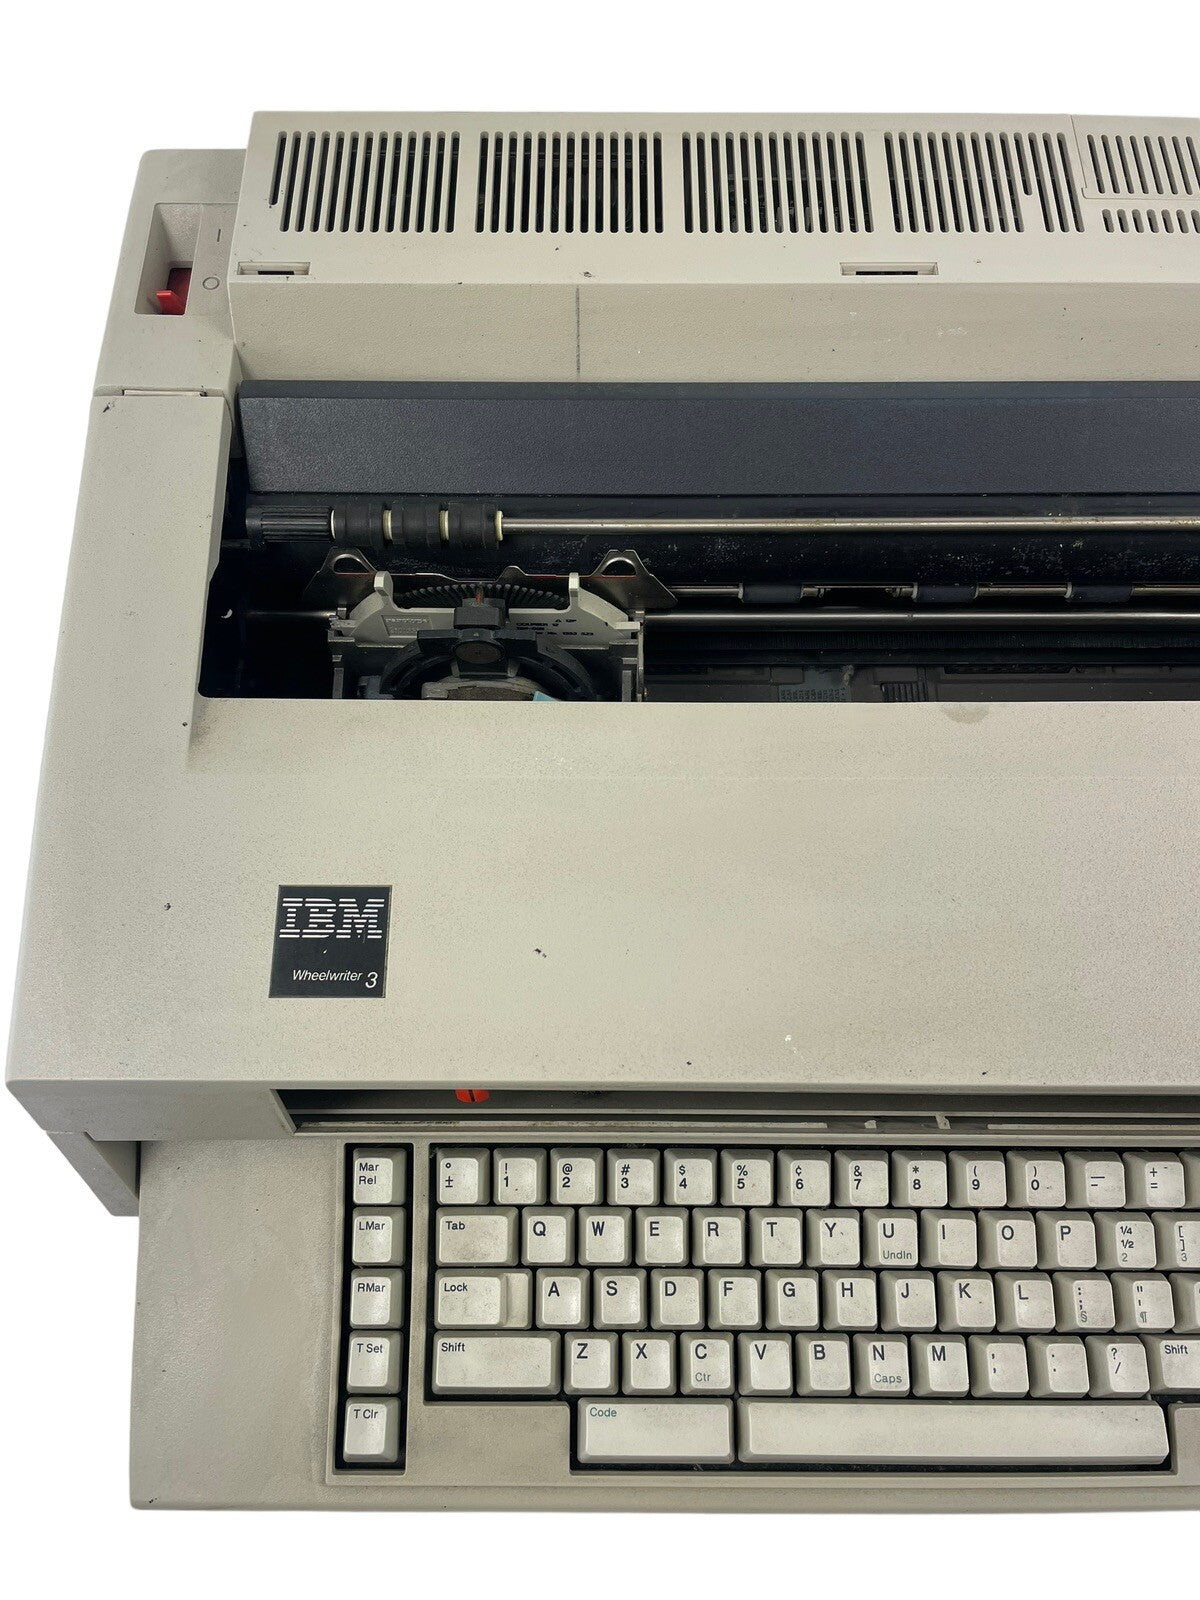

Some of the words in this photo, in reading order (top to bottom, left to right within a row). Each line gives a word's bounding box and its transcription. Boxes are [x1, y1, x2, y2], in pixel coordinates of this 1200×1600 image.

[279, 898, 385, 938] IBM
[292, 969, 363, 981] Wheelwriter
[365, 971, 378, 989] 3
[358, 1162, 380, 1172] Mar
[561, 1162, 573, 1176] @
[620, 1163, 631, 1176] #
[678, 1164, 686, 1177] $
[736, 1164, 749, 1177] %
[853, 1164, 863, 1177] &
[1149, 1167, 1158, 1178] +
[358, 1175, 377, 1185] Rel
[503, 1175, 509, 1188] 1
[561, 1176, 571, 1188] 2
[620, 1176, 630, 1189] 3
[678, 1177, 688, 1190] 4
[736, 1177, 746, 1190] 5
[795, 1178, 804, 1190] 6
[853, 1178, 862, 1190] 7
[912, 1178, 922, 1191] 8
[971, 1178, 981, 1191] 9
[1030, 1178, 1040, 1191] 0
[358, 1220, 386, 1231] LMar
[445, 1220, 466, 1231] Tab
[532, 1220, 547, 1237] Q
[591, 1220, 605, 1237] W
[649, 1221, 660, 1237] E
[707, 1221, 720, 1237] R
[766, 1221, 778, 1238] T
[824, 1222, 837, 1238] Y
[882, 1222, 895, 1239] U
[1177, 1225, 1185, 1239] [
[1001, 1224, 1015, 1241] O
[1060, 1225, 1072, 1241] P
[1179, 1238, 1186, 1252] ]
[1121, 1252, 1128, 1263] 2
[1180, 1252, 1188, 1263] 3
[357, 1282, 386, 1293] RMar
[444, 1282, 468, 1293] Lock
[547, 1281, 560, 1298] A
[606, 1280, 618, 1297] S
[664, 1280, 677, 1297] D
[723, 1280, 734, 1297] F
[782, 1281, 796, 1298] G
[841, 1281, 854, 1298] H
[900, 1282, 910, 1299] J
[958, 1282, 972, 1299] K
[1017, 1284, 1030, 1301] L
[356, 1342, 364, 1353] T
[365, 1342, 383, 1354] Set
[441, 1341, 466, 1353] Shift
[576, 1342, 589, 1359] Z
[635, 1342, 648, 1360] X
[694, 1342, 708, 1360] C
[754, 1343, 767, 1361] V
[813, 1343, 826, 1361] B
[872, 1344, 885, 1361] N
[931, 1345, 947, 1362] M
[1110, 1347, 1118, 1360] ?
[1164, 1344, 1189, 1355] Shift
[1114, 1361, 1122, 1375] /
[694, 1371, 712, 1383] Ctr
[874, 1373, 903, 1385] Caps
[353, 1408, 361, 1419] T
[362, 1408, 379, 1420] Clr
[589, 1406, 618, 1418] Code
